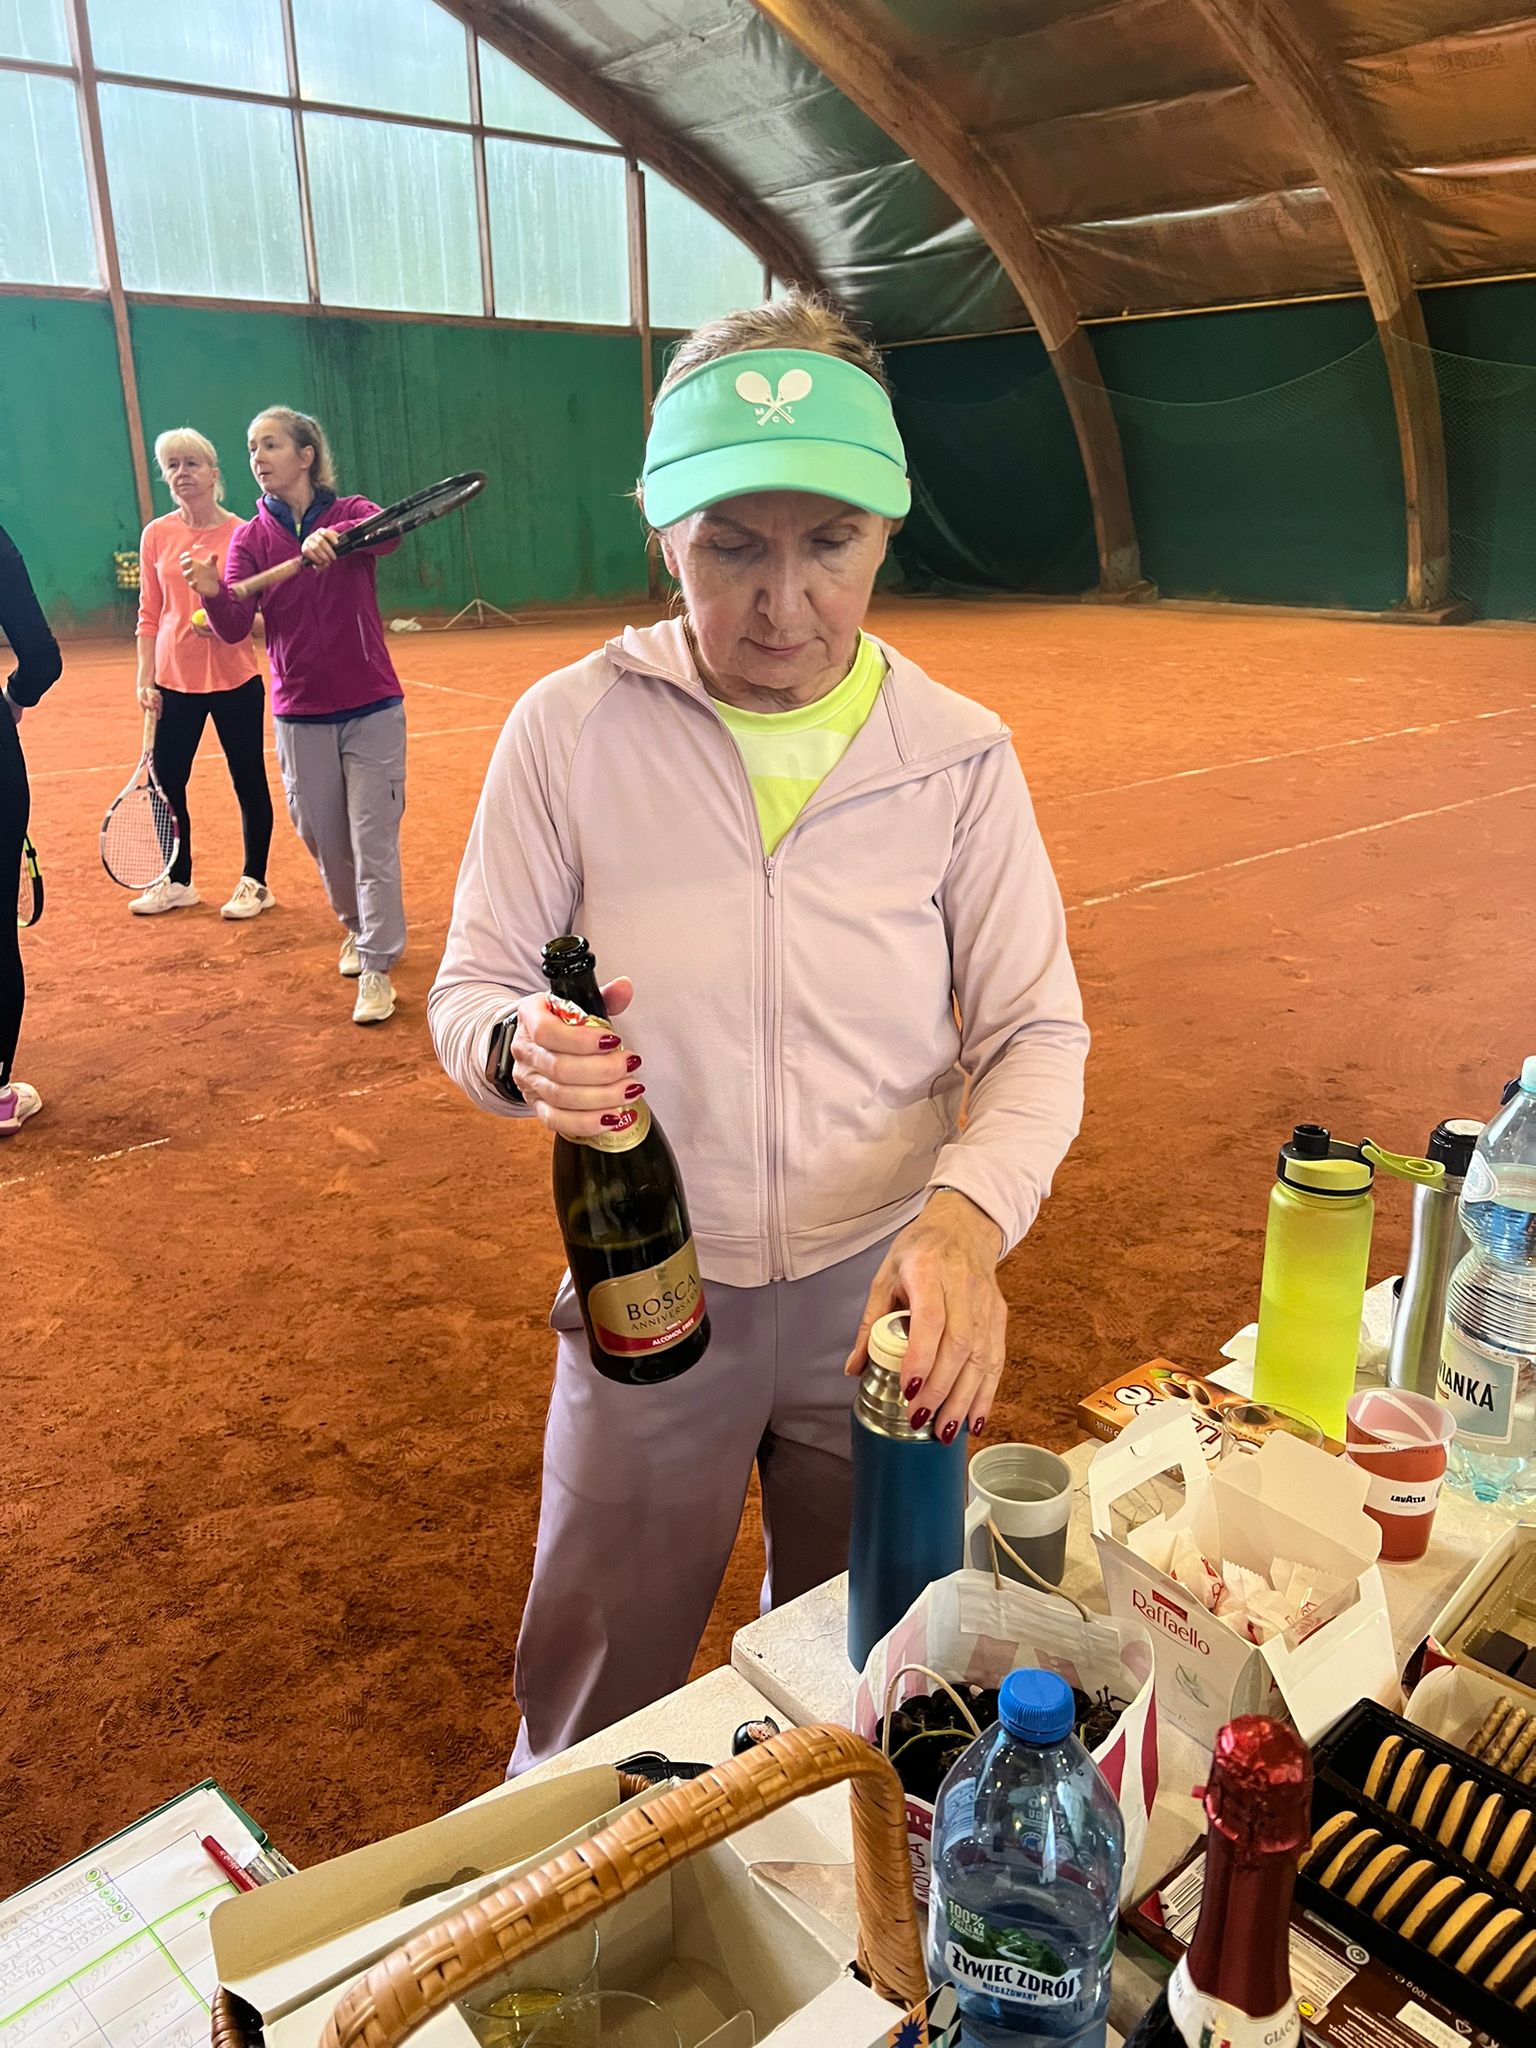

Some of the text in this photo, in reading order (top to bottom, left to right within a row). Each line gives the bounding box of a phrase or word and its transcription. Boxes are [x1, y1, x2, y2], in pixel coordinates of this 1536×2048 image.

[615, 1113, 632, 1129] 831
[626, 1273, 696, 1321] BOSCA
[652, 1328, 683, 1346] ALCOHOL
[1439, 1360, 1494, 1412] IANKA
[1390, 1494, 1426, 1504] LAVAZZA
[1132, 1588, 1210, 1656] Raffaello
[948, 1900, 985, 1930] 100%
[952, 1946, 1076, 1999] ŻYWIEC ZDRÓJ
[982, 1981, 1038, 2001] NIEGAZOWANY
